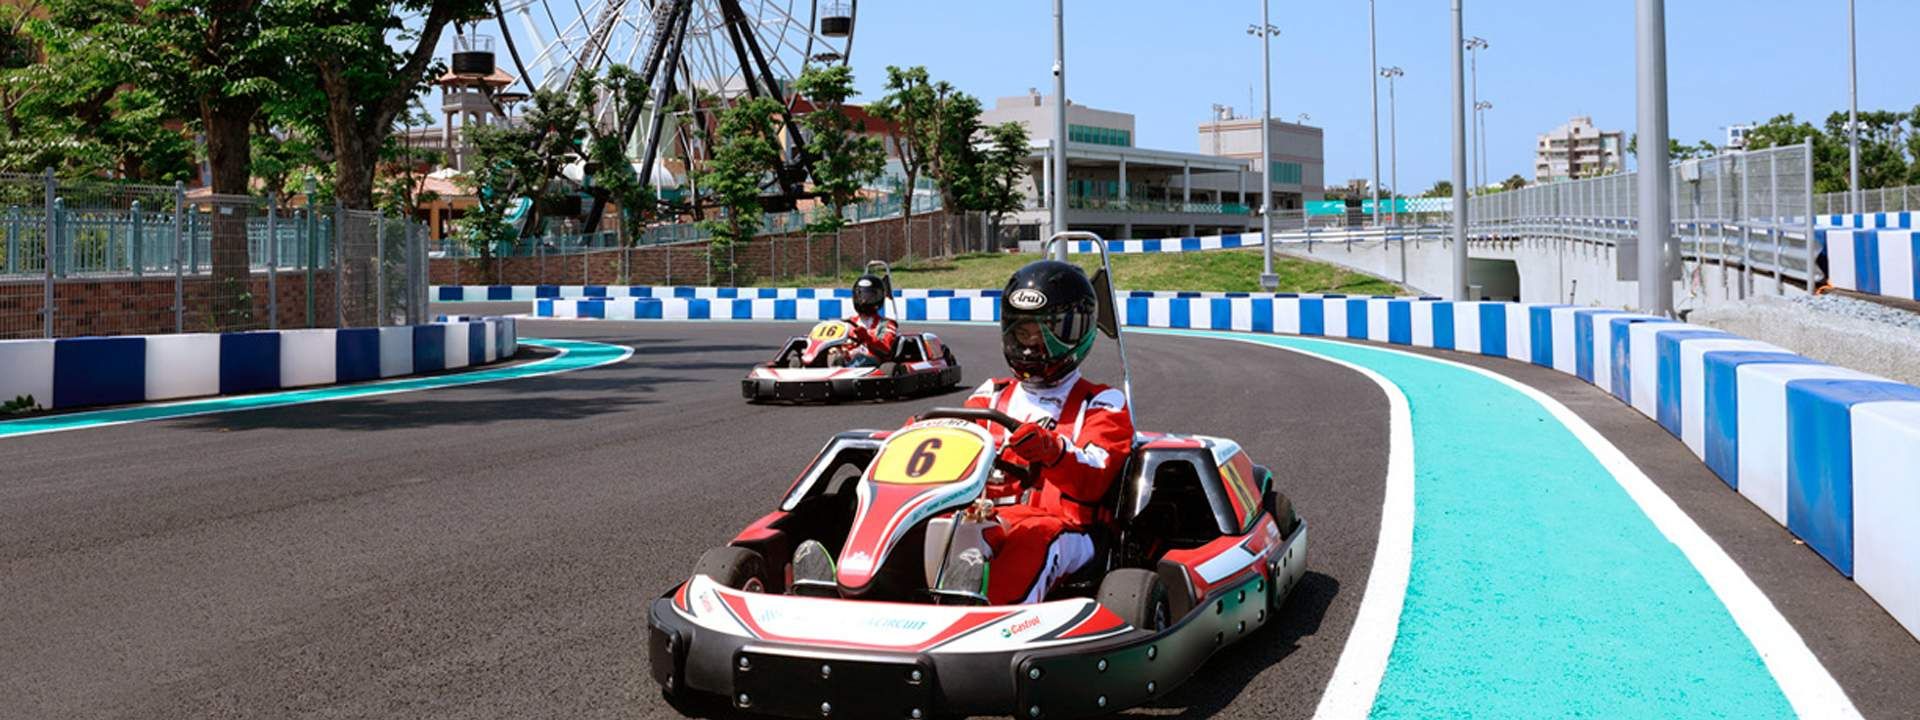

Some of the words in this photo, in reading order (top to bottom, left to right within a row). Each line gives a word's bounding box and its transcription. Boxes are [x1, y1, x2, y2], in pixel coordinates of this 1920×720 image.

[1014, 290, 1040, 303] Arai
[818, 325, 837, 338] 16
[906, 438, 942, 478] 6
[1011, 615, 1040, 634] Castrol
